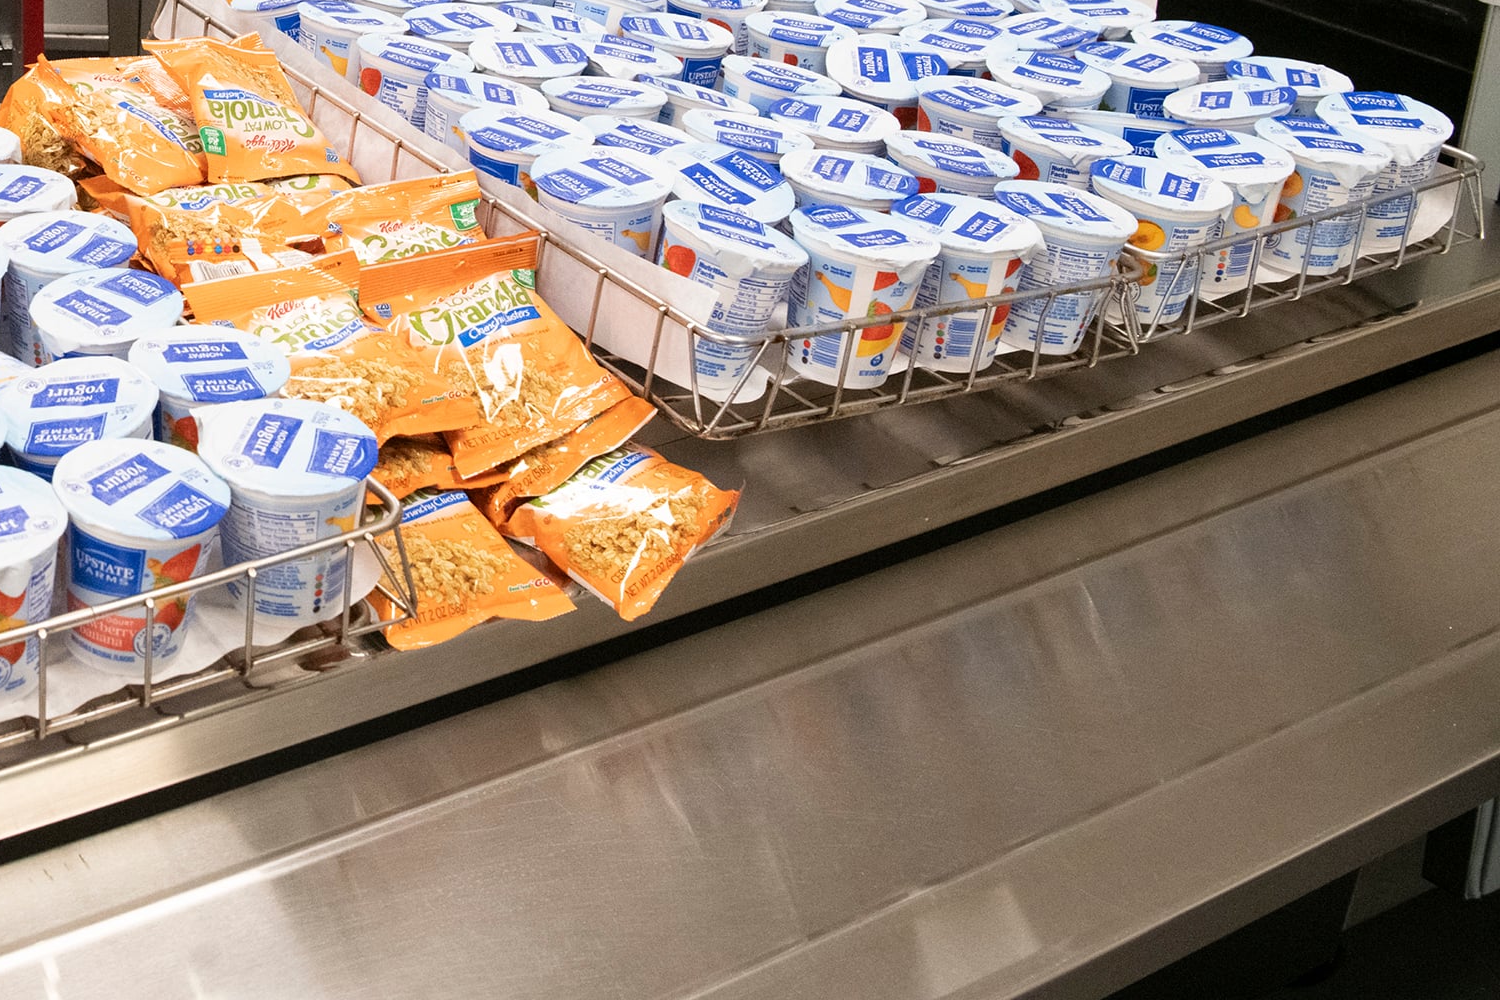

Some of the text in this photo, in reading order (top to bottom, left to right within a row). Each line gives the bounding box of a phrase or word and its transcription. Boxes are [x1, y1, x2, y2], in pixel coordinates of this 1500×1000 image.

[687, 66, 719, 80] UPSTAT
[1133, 103, 1164, 115] UPSTA
[208, 100, 315, 138] Granola
[243, 119, 288, 132] LOW FAT
[245, 135, 297, 152] Kellogg's
[599, 159, 640, 178] yogurt
[732, 155, 775, 186] UPSTATE
[693, 171, 737, 202] yogurt
[1310, 182, 1329, 190] Facts
[1311, 176, 1341, 187] Nutrition
[66, 297, 111, 323] yogurt
[173, 342, 233, 356] yogurt
[48, 381, 106, 398] yogurt
[252, 419, 281, 458] yogurt
[494, 431, 500, 440] 2
[100, 461, 148, 494] yogurt
[75, 548, 135, 580] UPSTATE
[79, 560, 129, 586] FARMS
[625, 582, 640, 599] NET
[639, 574, 654, 589] WT
[652, 570, 659, 580] 2
[429, 610, 435, 619] 2
[436, 606, 445, 618] OZ
